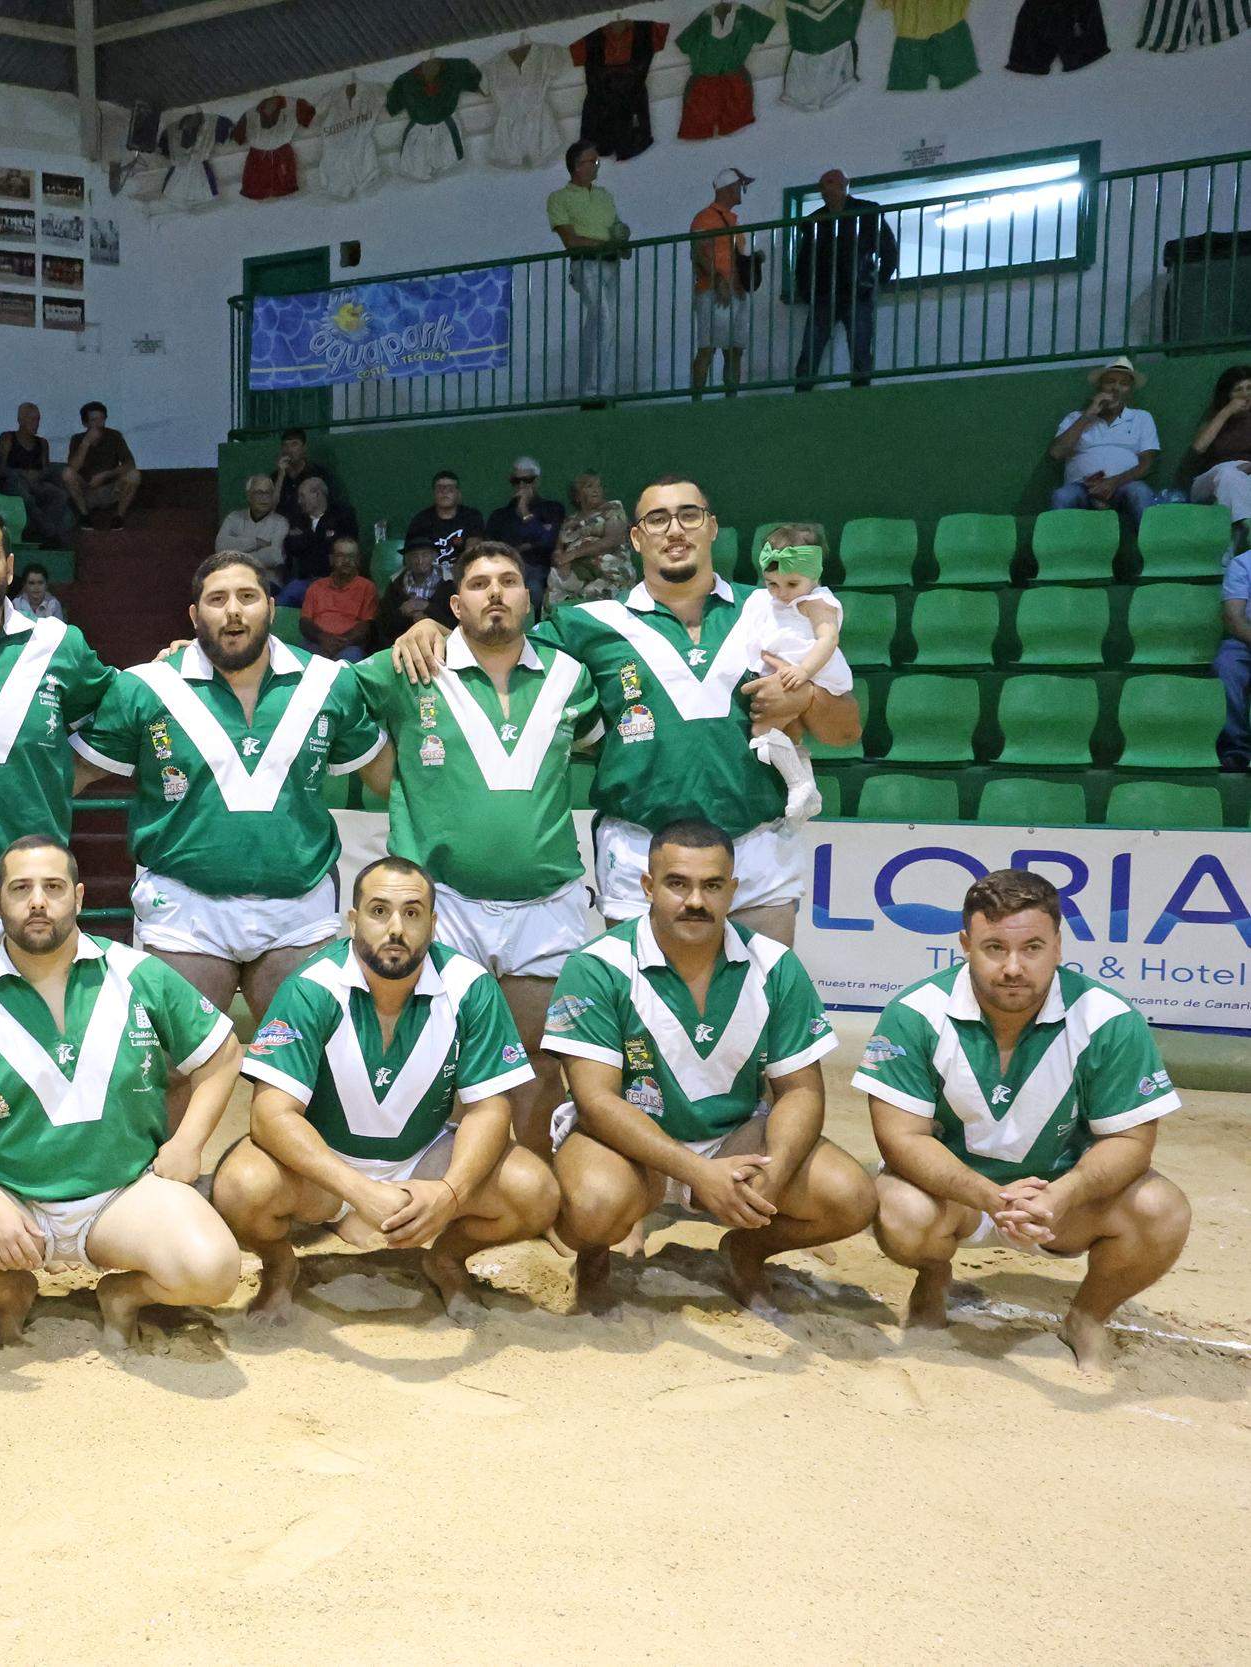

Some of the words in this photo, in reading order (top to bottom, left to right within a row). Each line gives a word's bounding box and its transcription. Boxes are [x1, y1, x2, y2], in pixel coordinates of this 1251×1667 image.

[310, 314, 454, 375] aquapark
[1098, 956, 1125, 979] &
[1141, 957, 1246, 986] Hotel
[817, 979, 865, 989] nuestra
[869, 981, 904, 993] mejor
[1183, 998, 1201, 1008] de
